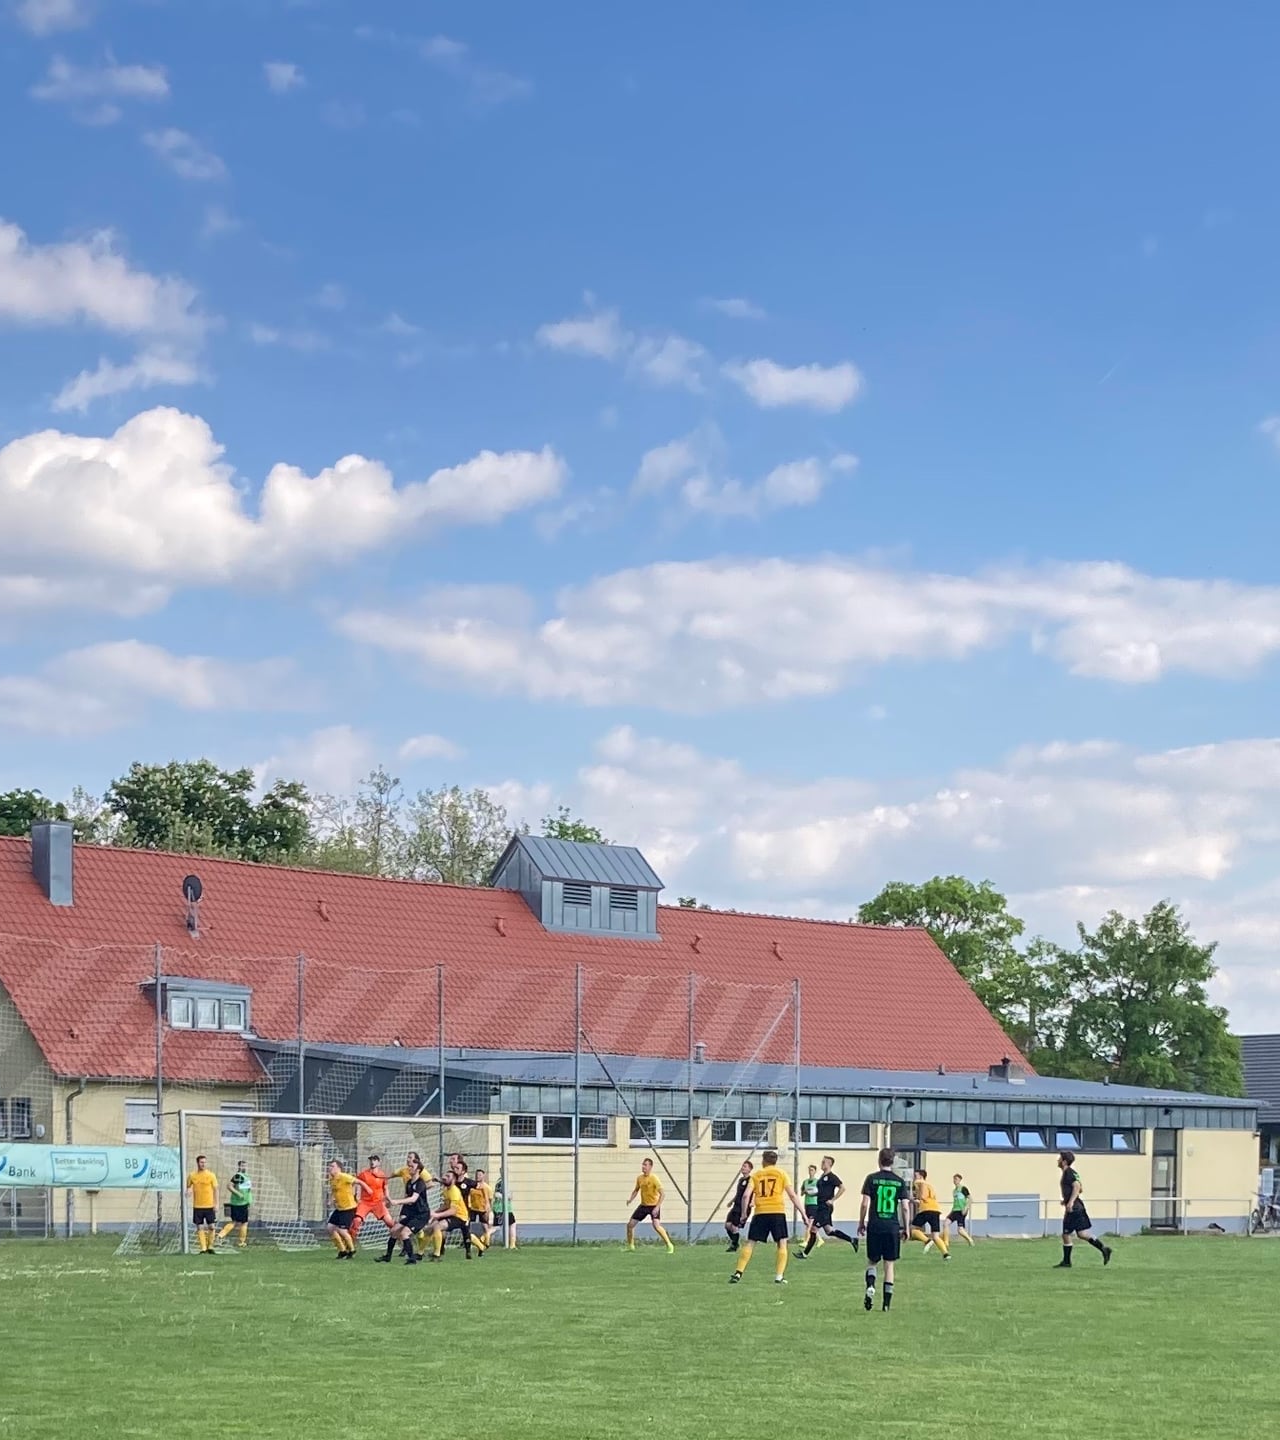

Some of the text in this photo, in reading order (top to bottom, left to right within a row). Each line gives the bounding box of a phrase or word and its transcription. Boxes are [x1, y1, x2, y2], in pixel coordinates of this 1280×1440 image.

[124, 1158, 139, 1169] BB
[8, 1165, 37, 1178] Bank
[150, 1168, 176, 1179] Bank
[758, 1178, 777, 1198] 17
[876, 1185, 897, 1213] 18
